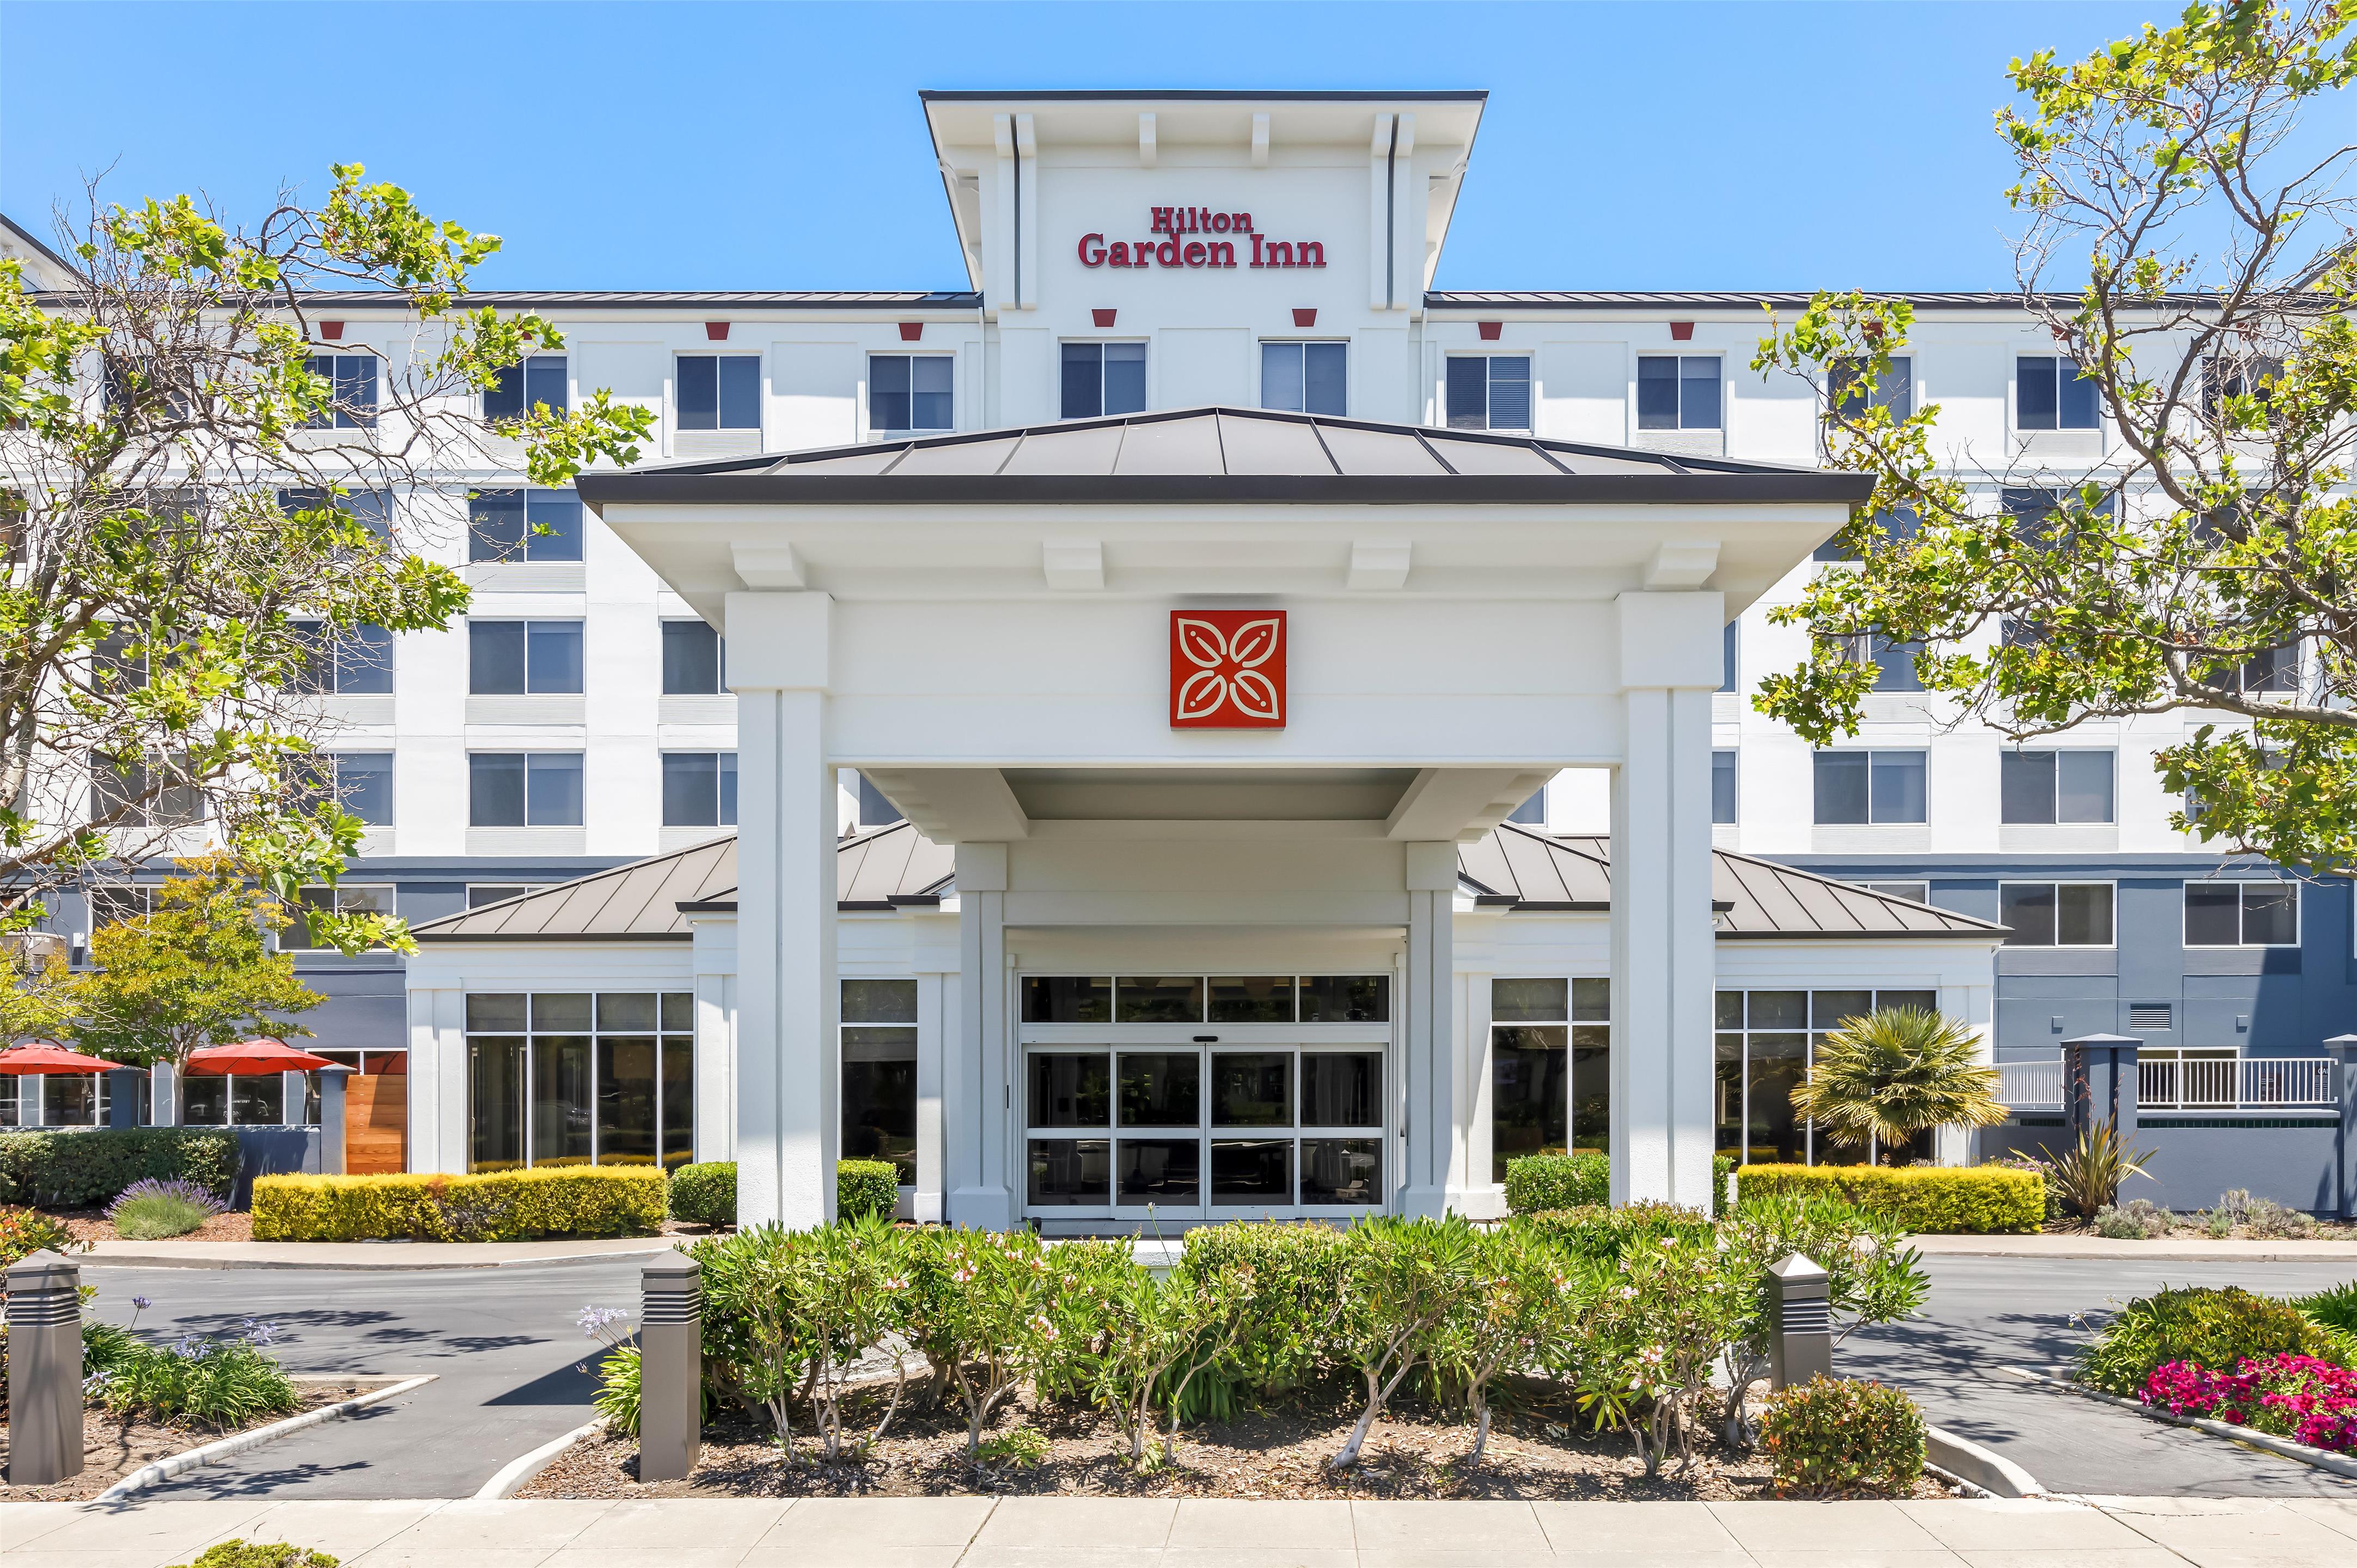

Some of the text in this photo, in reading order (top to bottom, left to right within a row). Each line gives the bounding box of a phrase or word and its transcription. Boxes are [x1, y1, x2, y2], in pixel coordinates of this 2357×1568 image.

[1151, 207, 1254, 233] Hilton
[1078, 233, 1327, 268] Garden Inn
